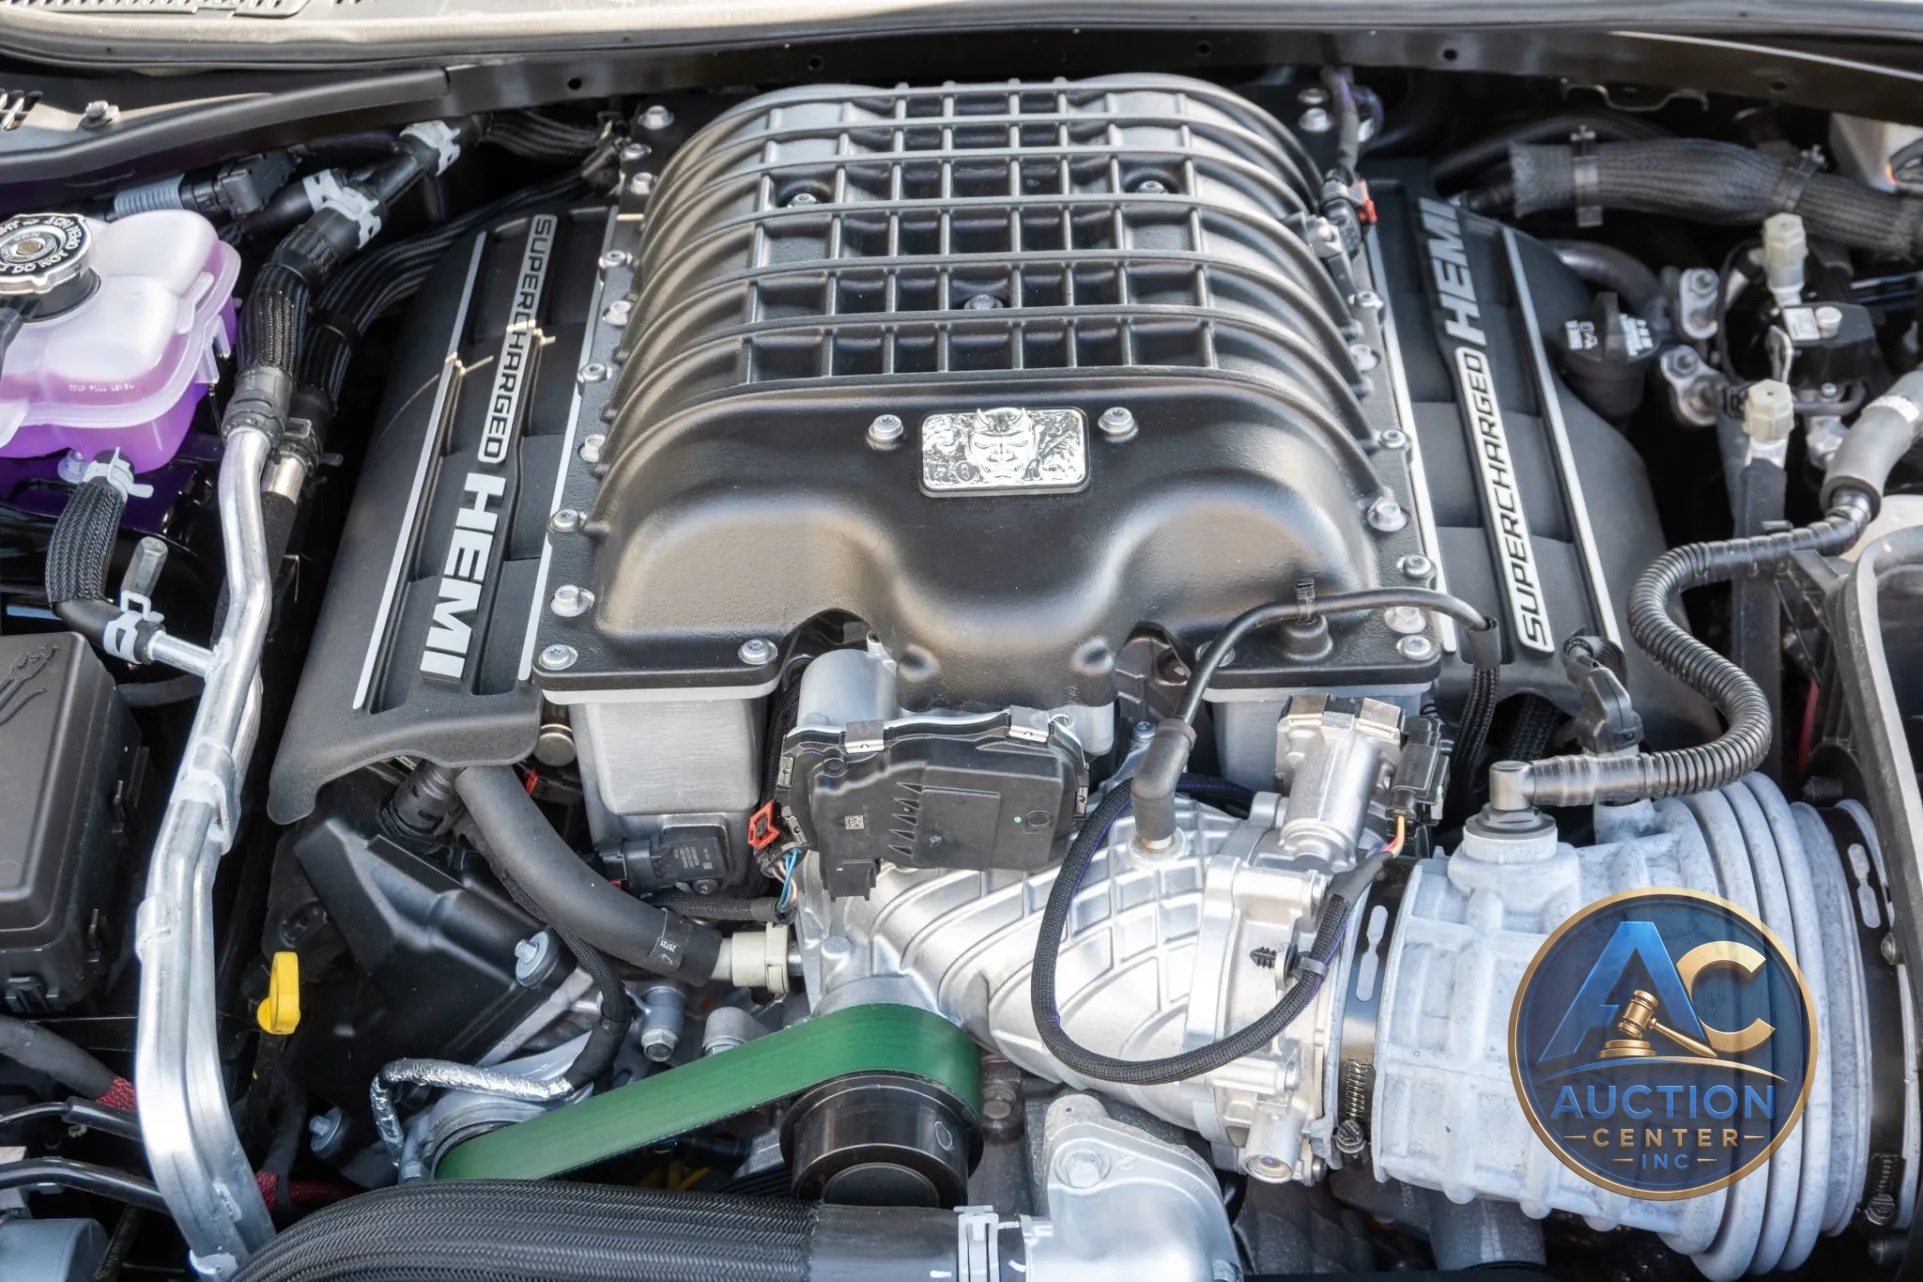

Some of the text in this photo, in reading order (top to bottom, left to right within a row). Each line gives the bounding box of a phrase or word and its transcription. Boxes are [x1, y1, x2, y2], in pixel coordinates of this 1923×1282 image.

[38, 249, 69, 268] NOT
[483, 217, 551, 459] SUPERCHARGED
[1419, 197, 1487, 346] HEMI
[420, 472, 506, 680] HEMI
[1463, 351, 1549, 647] SUPERCHARGED
